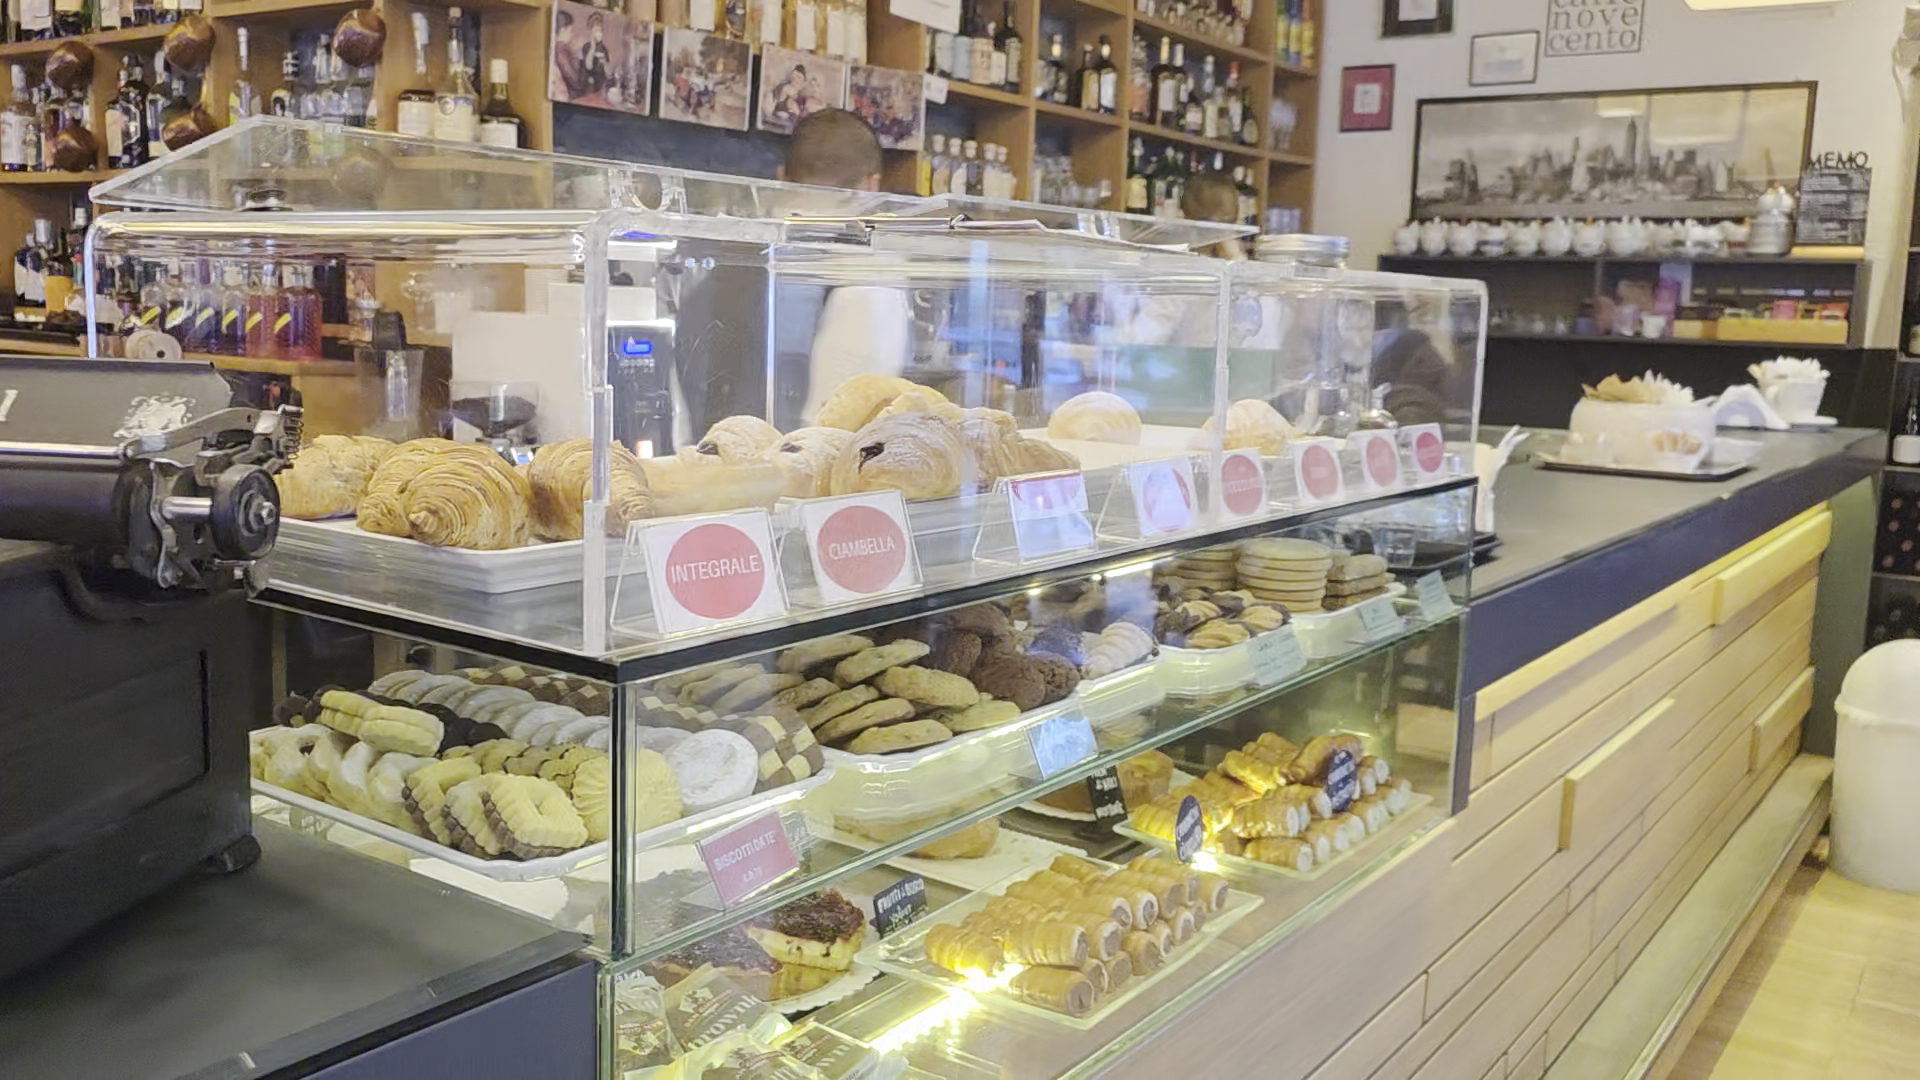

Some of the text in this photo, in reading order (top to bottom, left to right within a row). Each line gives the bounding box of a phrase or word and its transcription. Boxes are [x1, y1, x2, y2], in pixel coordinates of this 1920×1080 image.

[1553, 7, 1639, 30] nove
[1549, 27, 1637, 52] cento
[1807, 151, 1868, 169] MEMO
[829, 535, 896, 560] CIAMBELLA
[671, 554, 760, 584] INTEGRALE
